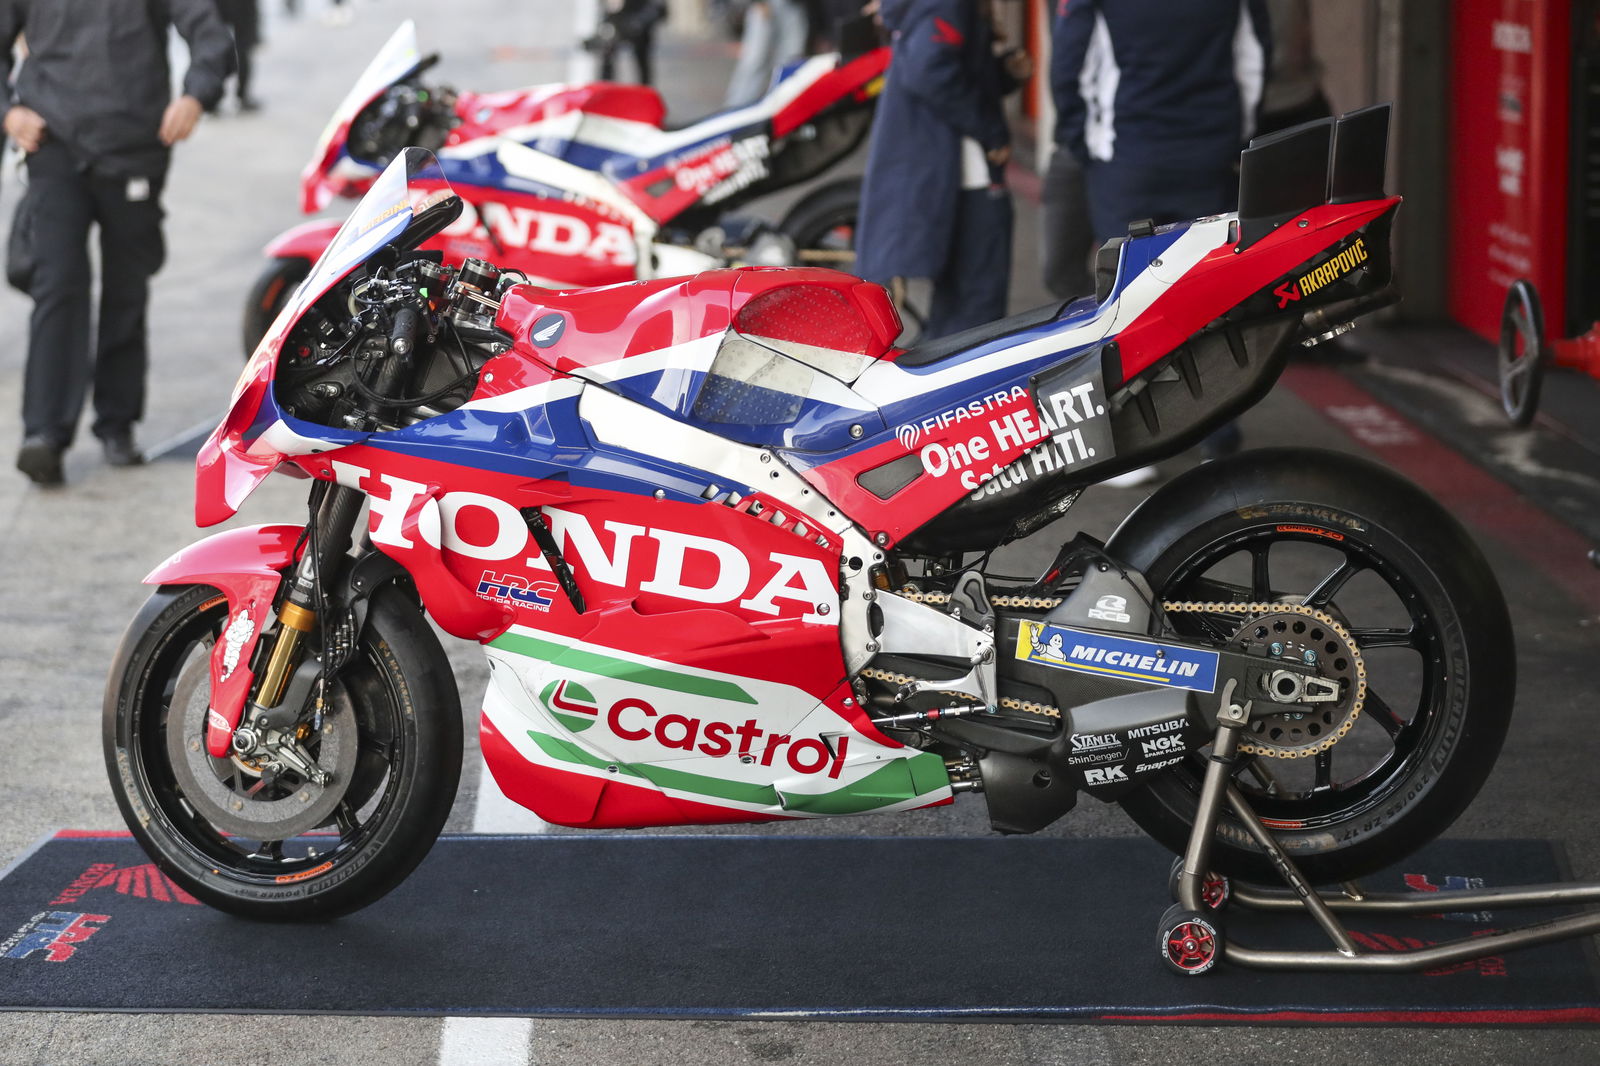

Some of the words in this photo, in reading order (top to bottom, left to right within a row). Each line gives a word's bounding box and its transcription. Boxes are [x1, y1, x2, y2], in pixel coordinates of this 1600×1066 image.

[921, 385, 1027, 435] FIFASTRA
[920, 436, 990, 477] One
[988, 382, 1104, 451] HEART.
[960, 459, 1028, 501] Satu
[1024, 428, 1096, 475] HATI.
[332, 460, 840, 626] HONDA
[476, 569, 560, 607] HRC
[476, 592, 511, 605] Honda
[511, 600, 550, 613] RACING
[1087, 608, 1130, 623] RCB
[1069, 644, 1200, 677] MICHELIN
[607, 697, 849, 780] Castrol
[1127, 718, 1190, 740] MITSUBA
[1070, 733, 1121, 751] STANLEY
[1141, 733, 1185, 754] NGK
[1068, 751, 1122, 765] ShinDengen
[1135, 756, 1185, 773] Snap-on
[1144, 750, 1165, 758] SPARK
[1083, 765, 1128, 783] RK
